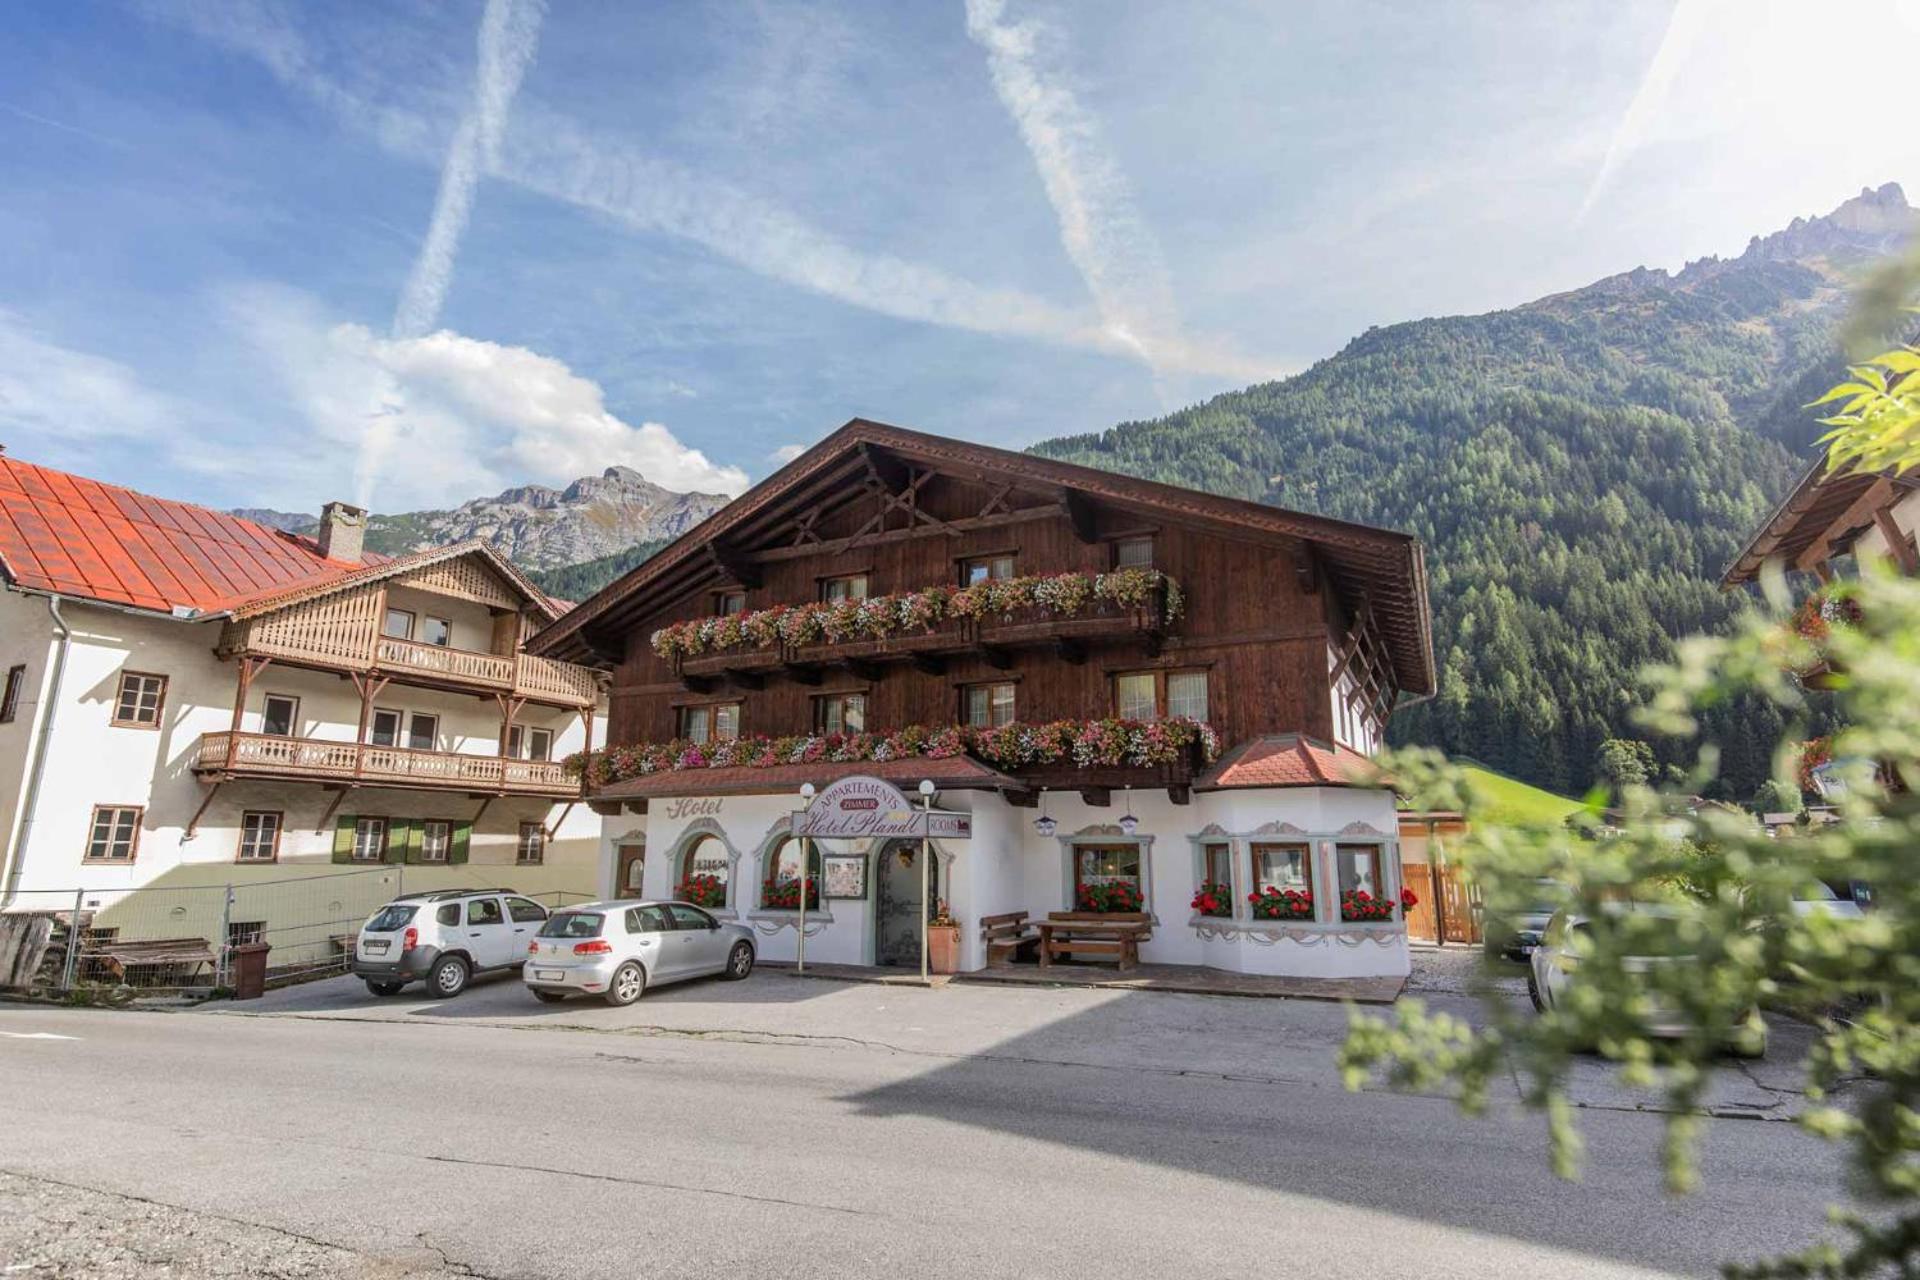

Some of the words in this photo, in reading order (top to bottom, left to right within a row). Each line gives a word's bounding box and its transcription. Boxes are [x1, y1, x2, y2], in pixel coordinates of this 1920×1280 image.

[821, 782, 898, 809] APPARTEMENTS
[843, 800, 877, 809] ZIMMER
[666, 798, 724, 819] Hotel
[800, 811, 849, 835] Hotel
[851, 812, 923, 836] Pfandl
[930, 818, 957, 832] ROOMS
